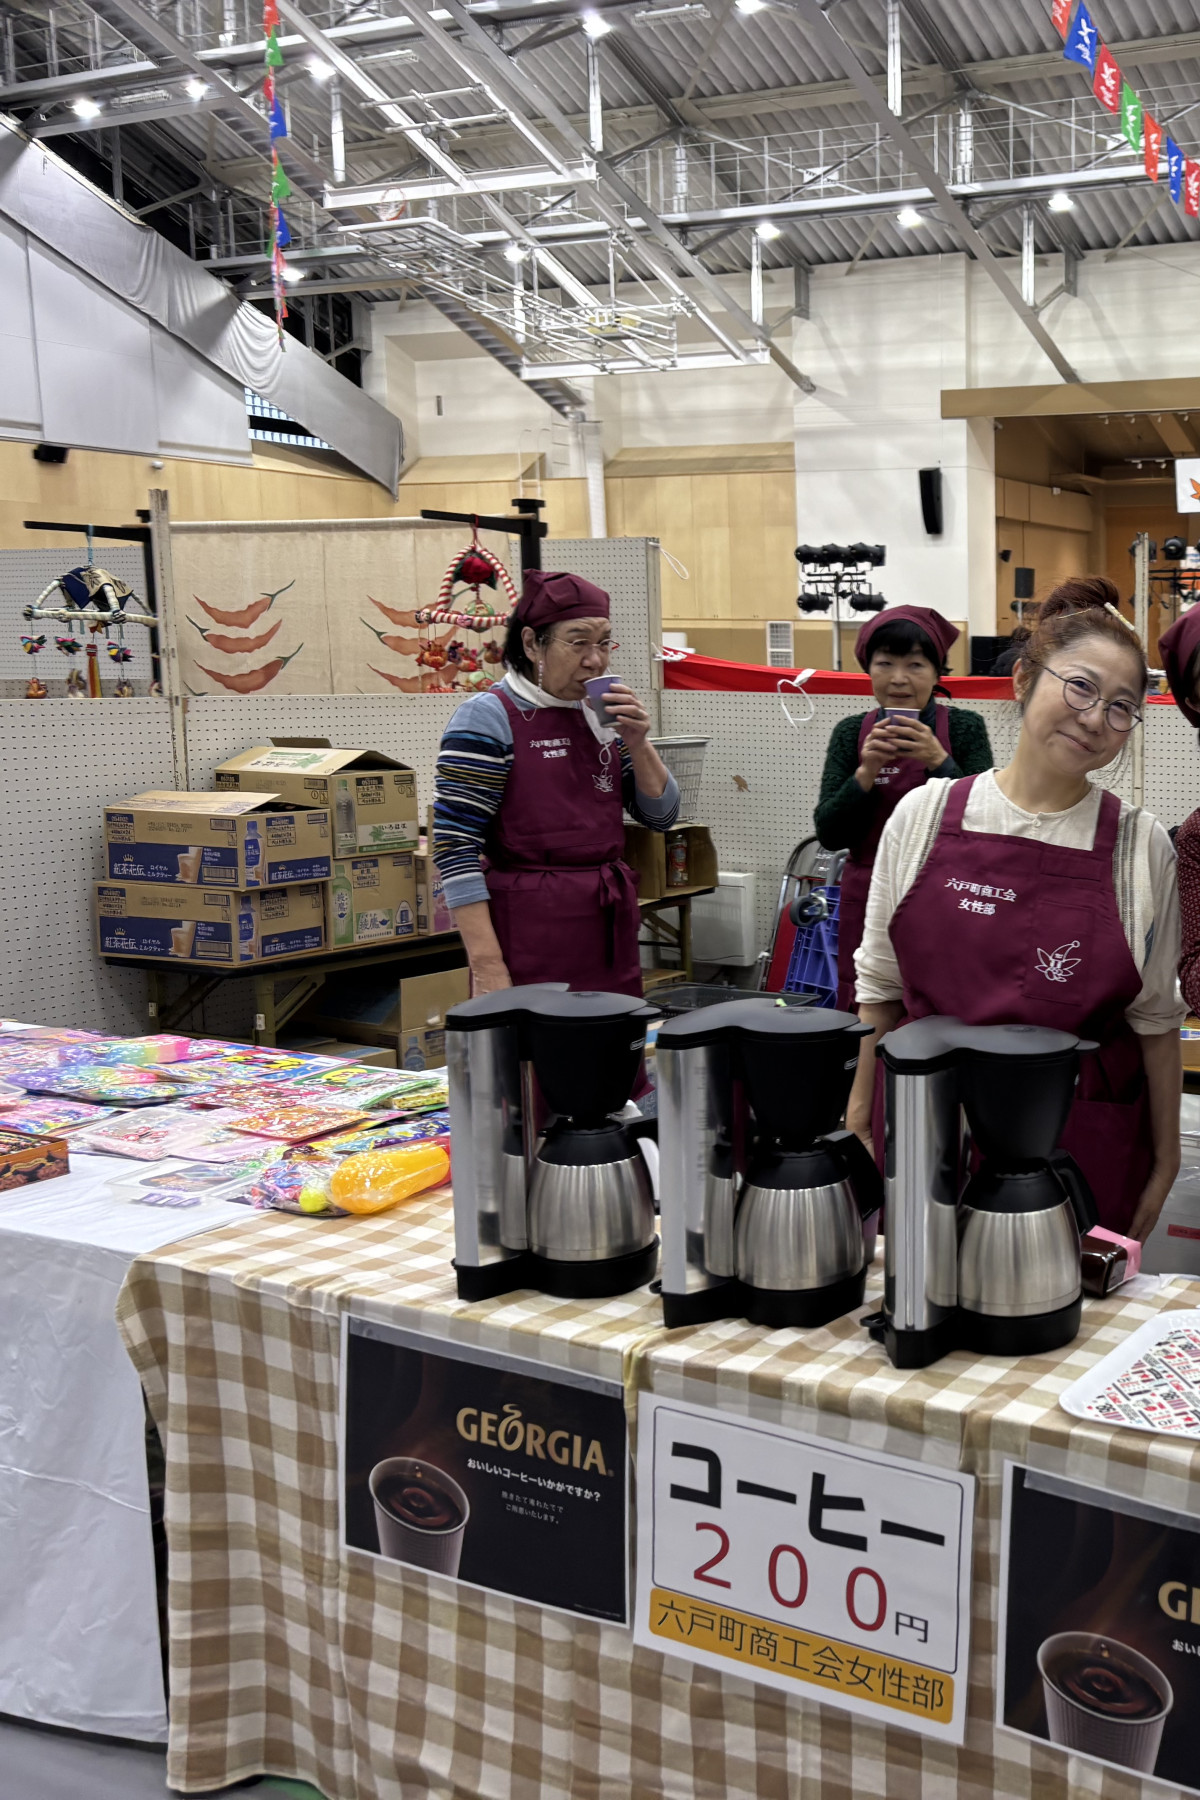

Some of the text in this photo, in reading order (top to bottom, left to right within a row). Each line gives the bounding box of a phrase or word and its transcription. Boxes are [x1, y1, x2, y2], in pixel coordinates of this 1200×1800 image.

[944, 877, 1017, 903] 六戸町商工会
[958, 898, 996, 916] 女性部
[456, 1403, 608, 1476] GEORGIA
[669, 1441, 946, 1552] コーヒー
[657, 1600, 946, 1712] 六戸町商工会女性部
